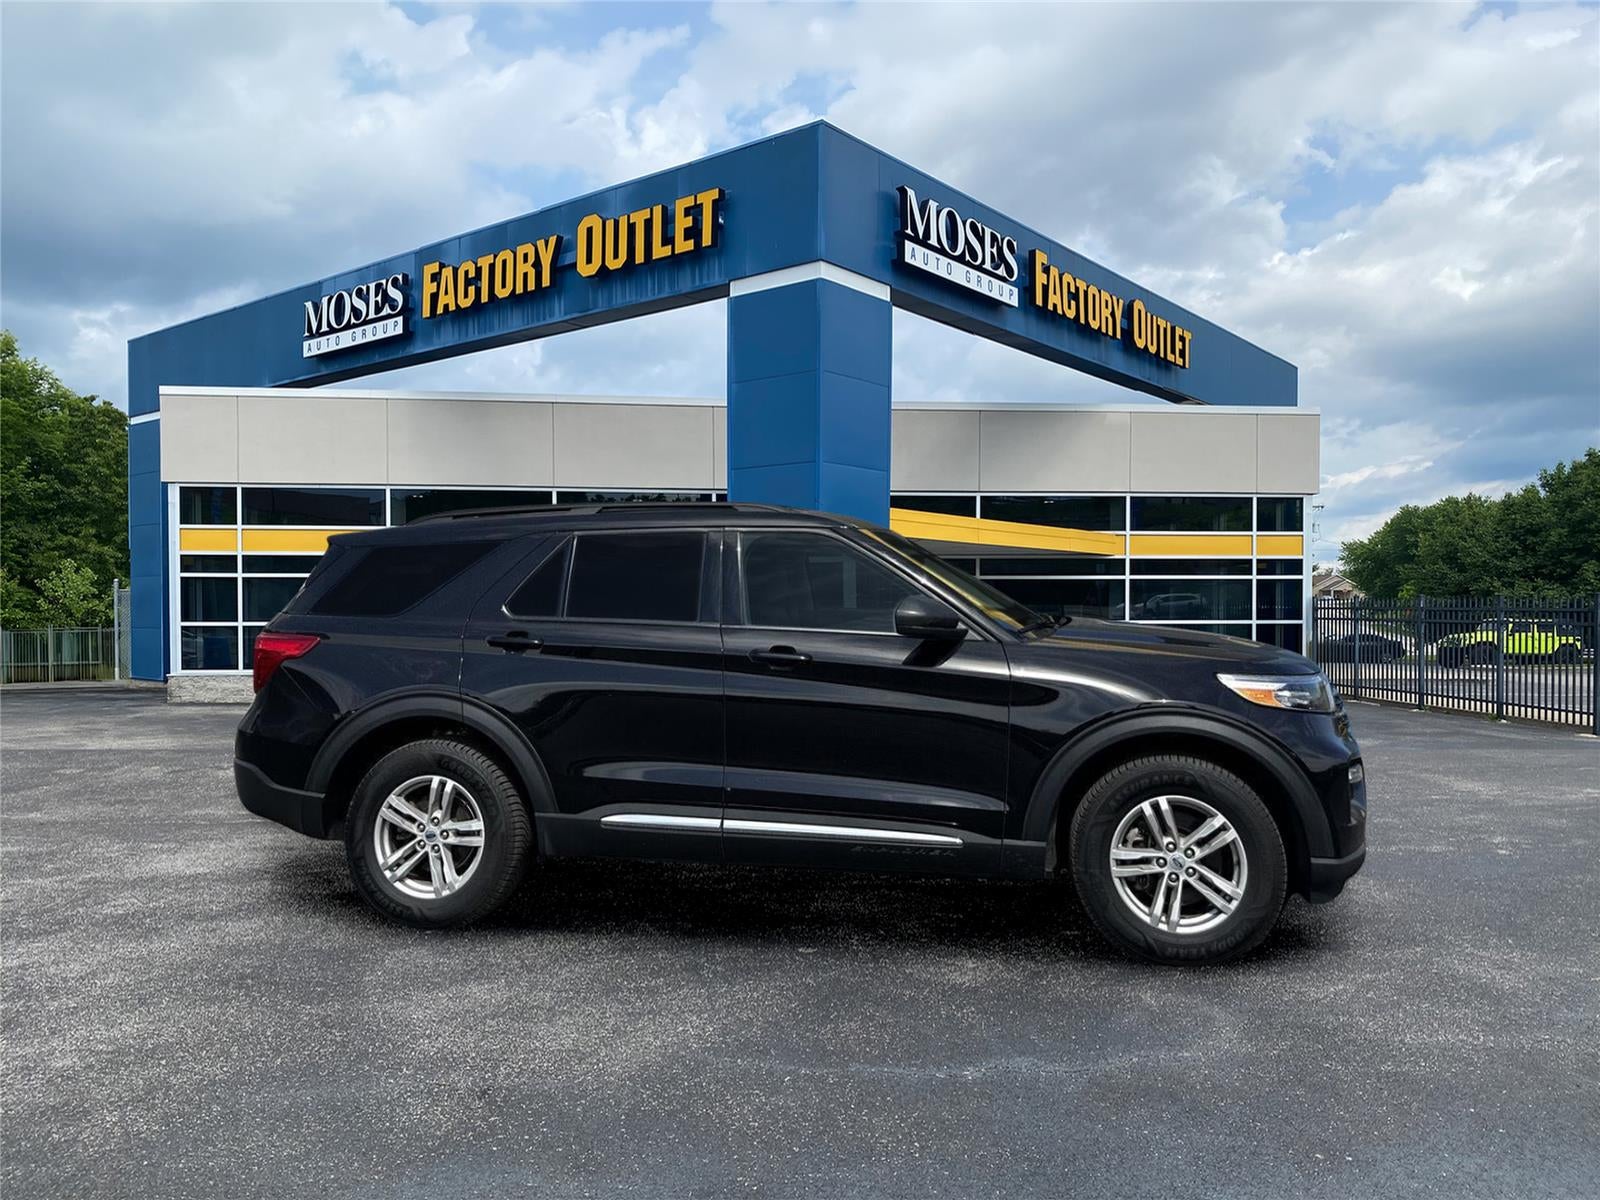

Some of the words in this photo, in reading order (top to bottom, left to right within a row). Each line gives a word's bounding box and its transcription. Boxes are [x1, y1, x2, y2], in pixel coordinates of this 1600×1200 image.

[422, 234, 559, 318] FACTORY
[577, 187, 720, 278] OUTLET
[903, 185, 1018, 282] MOSES
[910, 246, 953, 276] AUTO
[965, 270, 1014, 301] GROUP
[303, 273, 404, 337] MOSES
[307, 335, 340, 353] AUTO
[351, 320, 399, 342] GROUP
[1035, 249, 1124, 339] FACTORY
[1132, 299, 1192, 368] OUTLET
